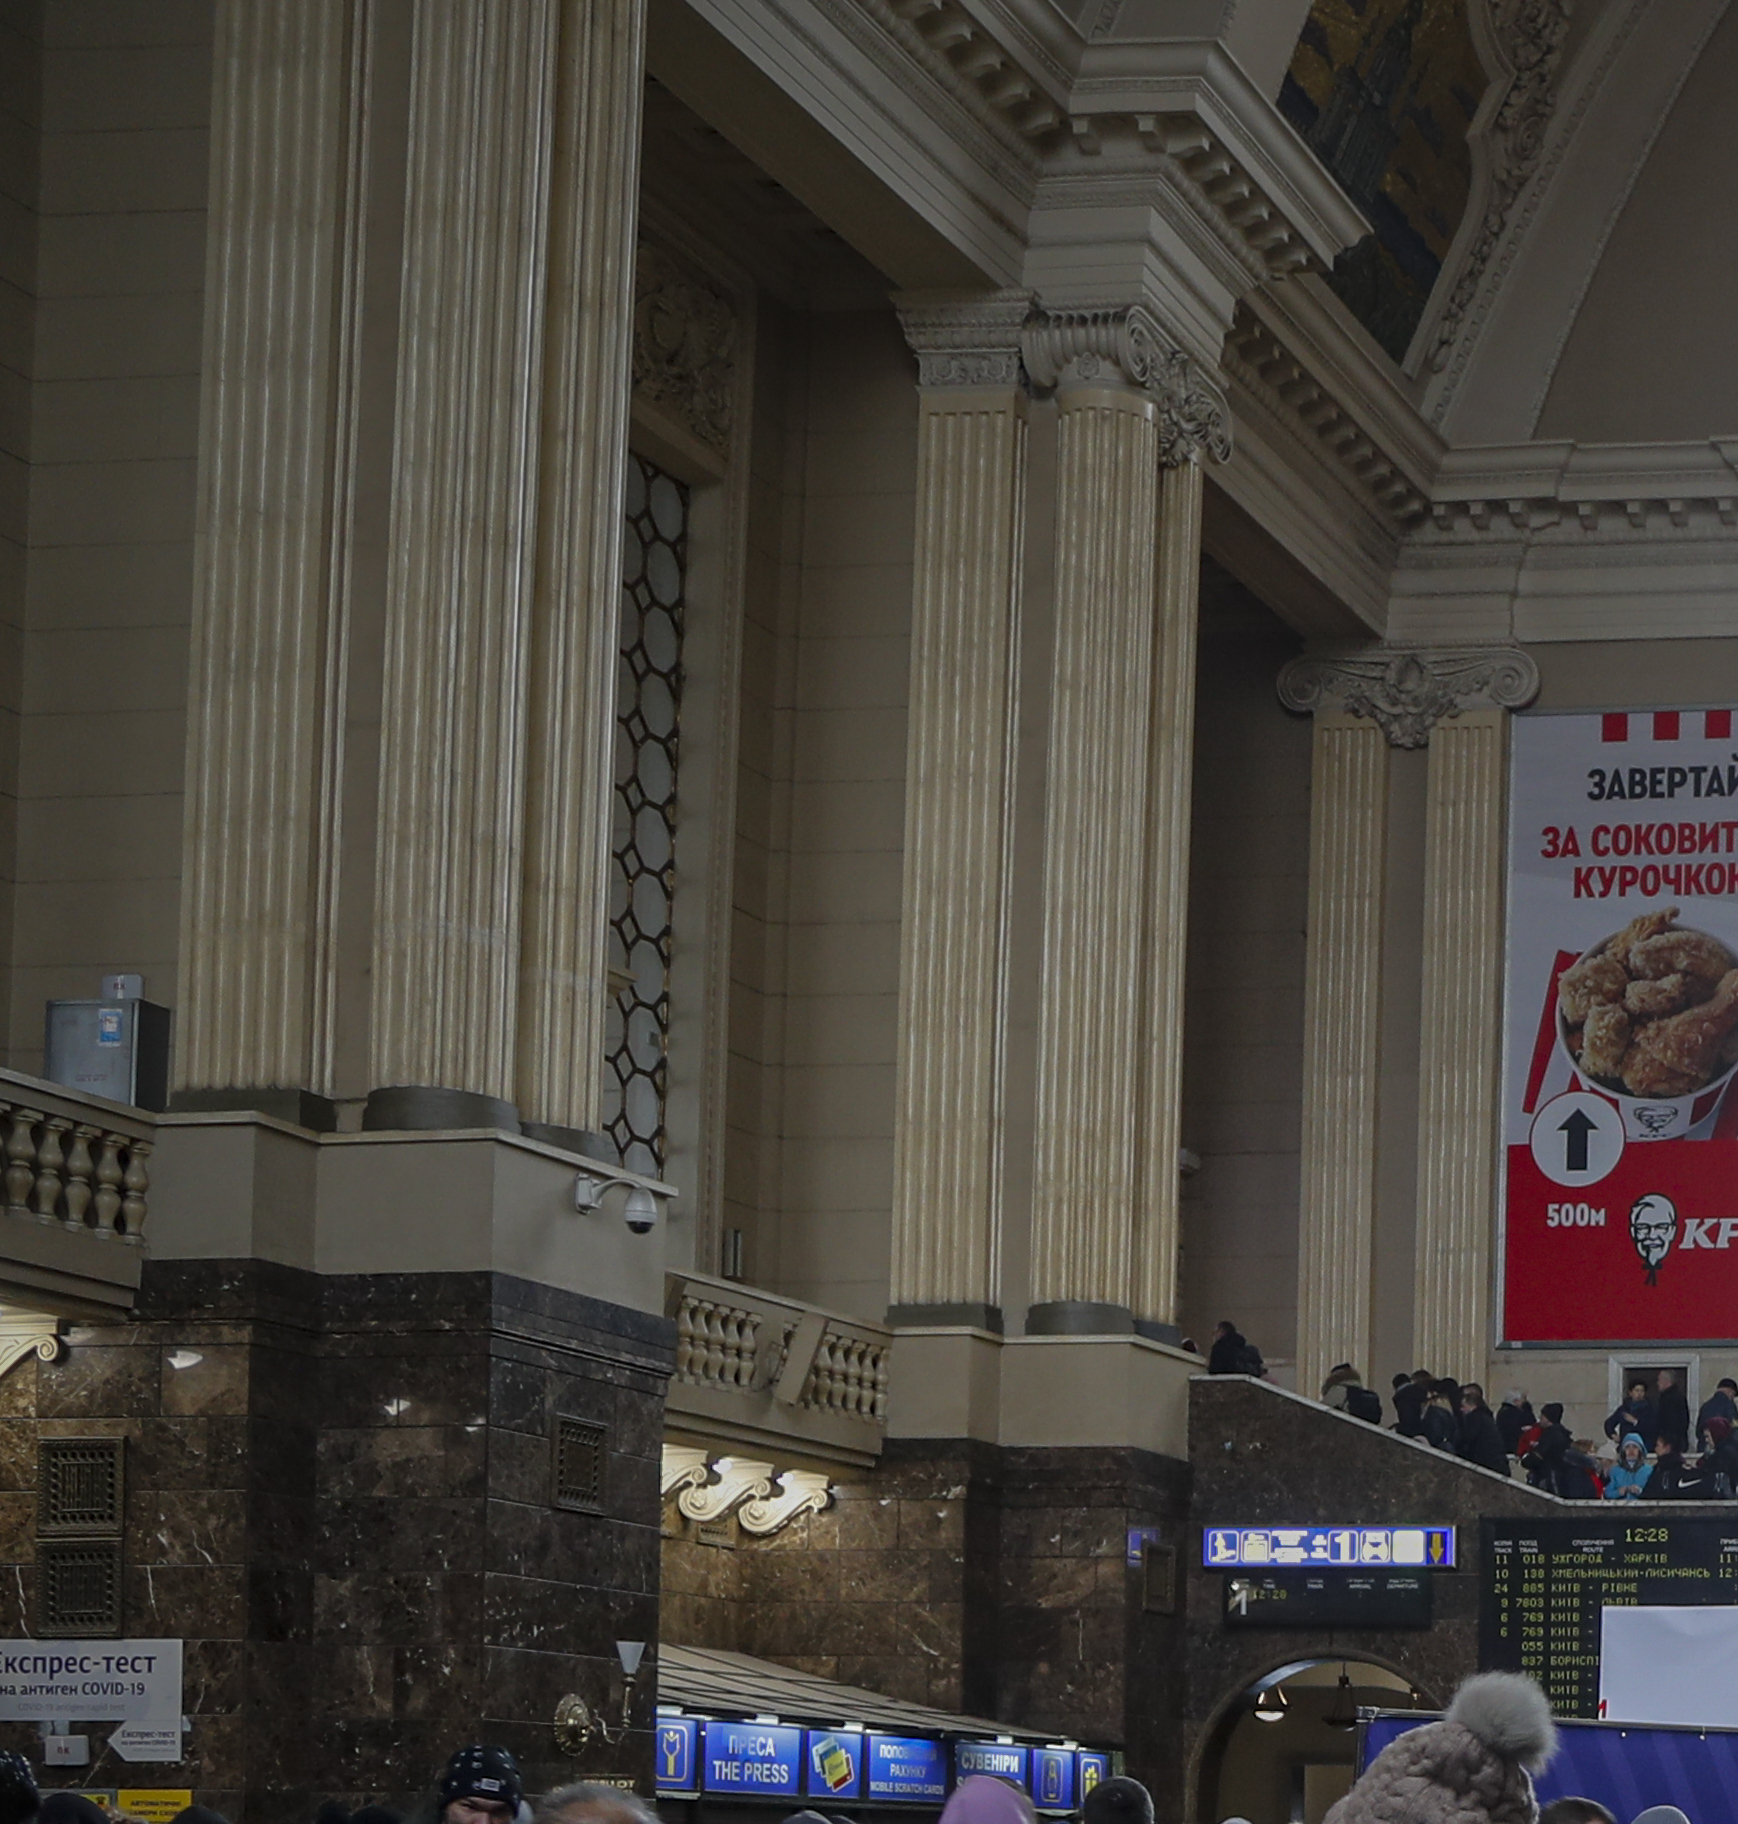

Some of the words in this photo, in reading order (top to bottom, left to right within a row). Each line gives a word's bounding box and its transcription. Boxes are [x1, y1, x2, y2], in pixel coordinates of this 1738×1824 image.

[1540, 826, 1581, 859] ЗА
[1625, 1528, 1668, 1542] 12:28
[1494, 1554, 1508, 1565] 11
[1522, 1554, 1546, 1565] 018
[1551, 1553, 1603, 1565] УЖГОРОД
[1623, 1553, 1668, 1564] ХАРКІВ
[1494, 1569, 1509, 1579] 10
[1601, 1583, 1638, 1593] РІВНЕ
[0, 1684, 18, 1696] на
[20, 1683, 78, 1696] антиген
[82, 1682, 145, 1696] COVID-19
[729, 1735, 776, 1757] ПРЕСА
[961, 1752, 1019, 1773] СУВЕНІРИ
[713, 1760, 741, 1781] THE
[744, 1762, 789, 1784] PRESS
[870, 1781, 893, 1793] MOBILE
[893, 1783, 923, 1794] SCRATCH
[923, 1784, 944, 1796] CARDS
